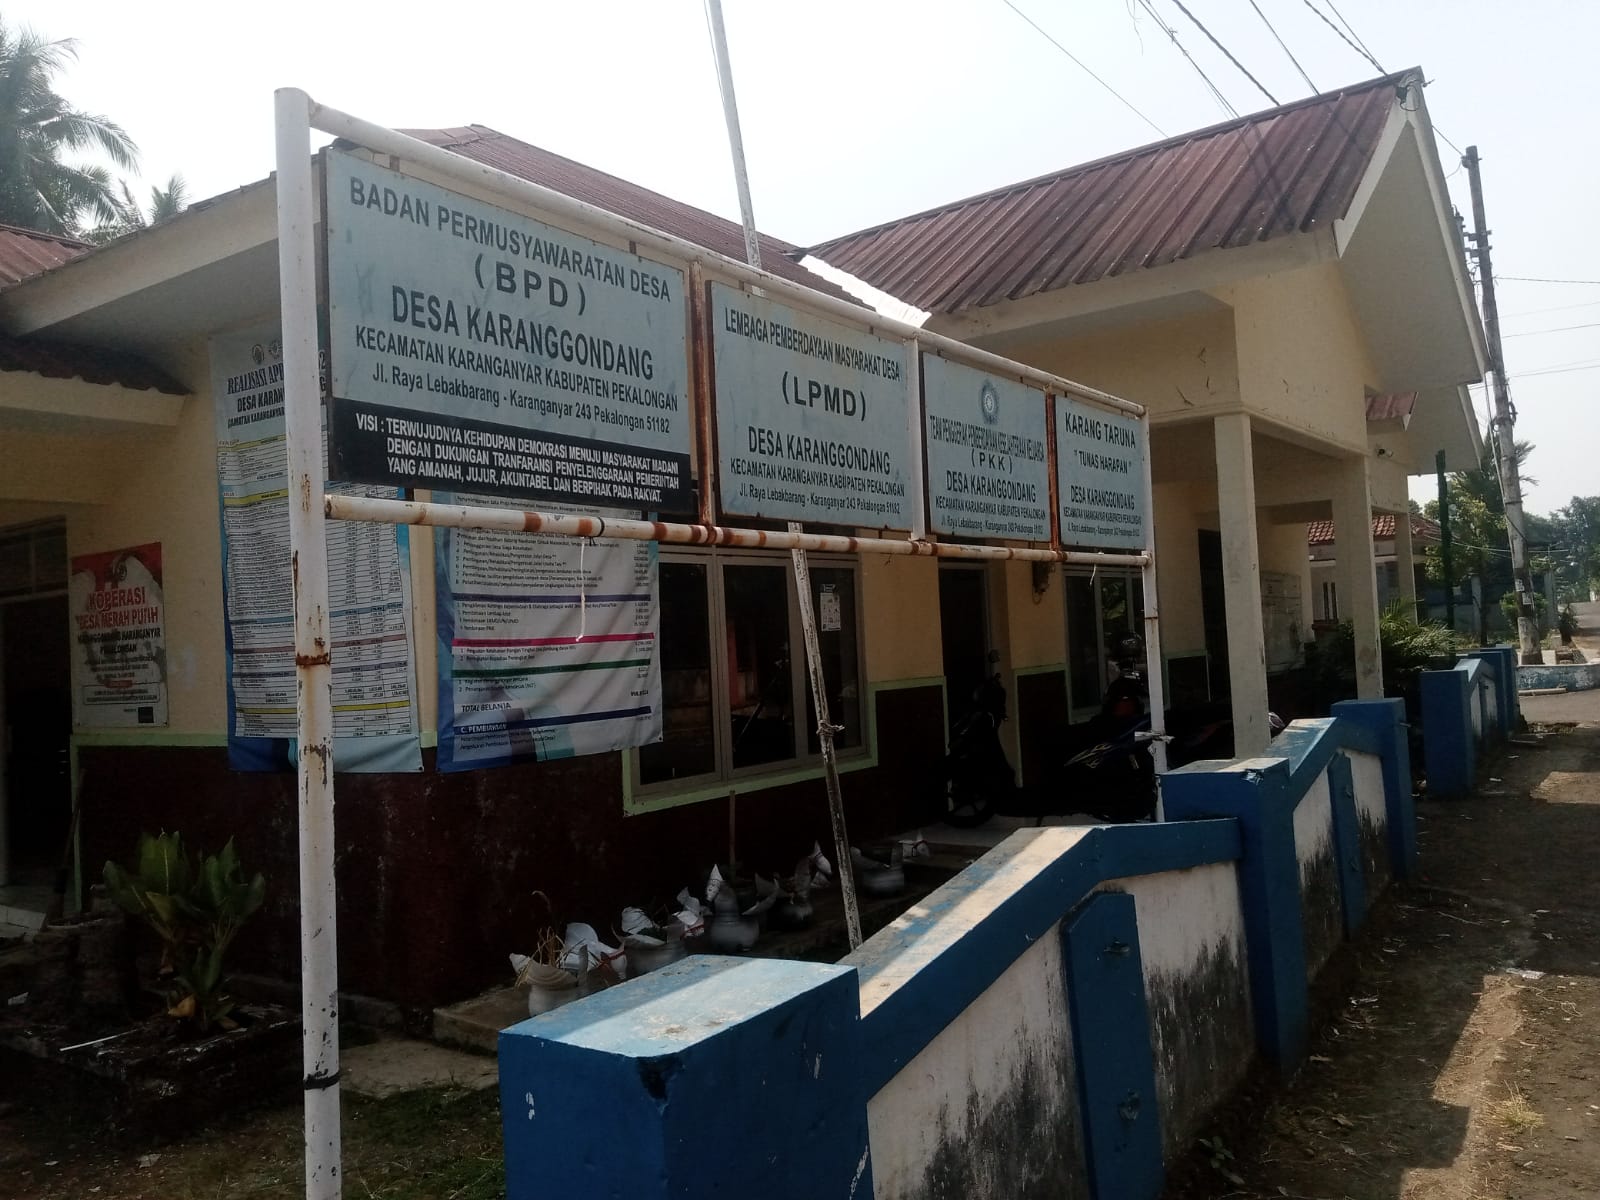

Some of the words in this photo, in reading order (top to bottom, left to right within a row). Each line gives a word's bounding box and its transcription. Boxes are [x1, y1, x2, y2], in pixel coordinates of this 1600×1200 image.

[351, 176, 429, 227] BADAN
[438, 205, 625, 289] PERMUSYAWARATAN
[631, 268, 671, 302] DESA
[392, 285, 459, 336] DESA
[467, 307, 654, 380] KARANGGONDANG
[725, 307, 769, 343] LEMBAGA
[769, 321, 833, 363] PEMBERDAYAAN
[834, 342, 881, 377] MASYARAKAT
[882, 358, 900, 382] DESA
[227, 368, 267, 395] REALISASI
[356, 325, 444, 364] KECAMATAN
[448, 346, 542, 383] KARANGANYAR
[545, 368, 609, 398] KABUPATEN
[612, 384, 678, 412] PEKALONGAN
[237, 395, 257, 412] DESA
[373, 364, 387, 384] Jl.
[392, 368, 423, 392] Raya
[427, 374, 500, 408] Lebakbarang
[510, 389, 572, 418] Karanganyar
[575, 404, 592, 420] 243
[594, 407, 644, 432] Pekalongan
[647, 416, 670, 433] 51182
[356, 413, 378, 433] VISI
[386, 417, 463, 445] TERWUJUDNYA
[464, 431, 516, 453] KEHIDUPAN
[518, 438, 567, 460] DEMOKRASI
[569, 445, 601, 464] MENUJU
[603, 449, 651, 470] MASYARAKAT
[652, 459, 678, 475] MADANI
[748, 426, 784, 458] DESA
[787, 434, 890, 475] KARANGGONDANG
[1065, 412, 1101, 440] KARANG
[1104, 423, 1136, 449] TARUNA
[387, 437, 431, 458] DENGAN
[435, 444, 489, 465] DUKUNGAN
[492, 452, 553, 474] TRANFARANSI
[555, 461, 633, 485] PENYELENGGARAAN
[635, 471, 679, 490] PEMERINTAH
[387, 457, 416, 475] YANG
[418, 462, 464, 484] AMANAH,
[466, 467, 499, 488] JUJUR,
[500, 471, 552, 491] AKUNTABEL
[553, 477, 571, 493] DAN
[572, 480, 612, 498] BERPIHAK
[613, 485, 632, 500] PADA
[633, 488, 662, 503] RAKYAT.
[731, 457, 776, 480] KECAMATAN
[777, 466, 828, 487] KARANGANYAR
[829, 474, 866, 492] KABUPATEN
[867, 479, 905, 497] PEKALONGAN
[750, 484, 766, 501] Raya
[767, 488, 805, 507] Lebakbarang
[810, 493, 845, 511] Karanganyar
[857, 500, 885, 515] Pekalongan
[935, 495, 965, 512] KECAMATAN
[947, 470, 968, 493] DESA
[971, 475, 1036, 503] KARANGGONDANG
[1071, 485, 1086, 503] DESA
[1087, 487, 1135, 510] KARANGGONDANG
[88, 587, 145, 611] KOPERASI
[101, 611, 129, 628] MERAH
[132, 607, 158, 625] PUTIH
